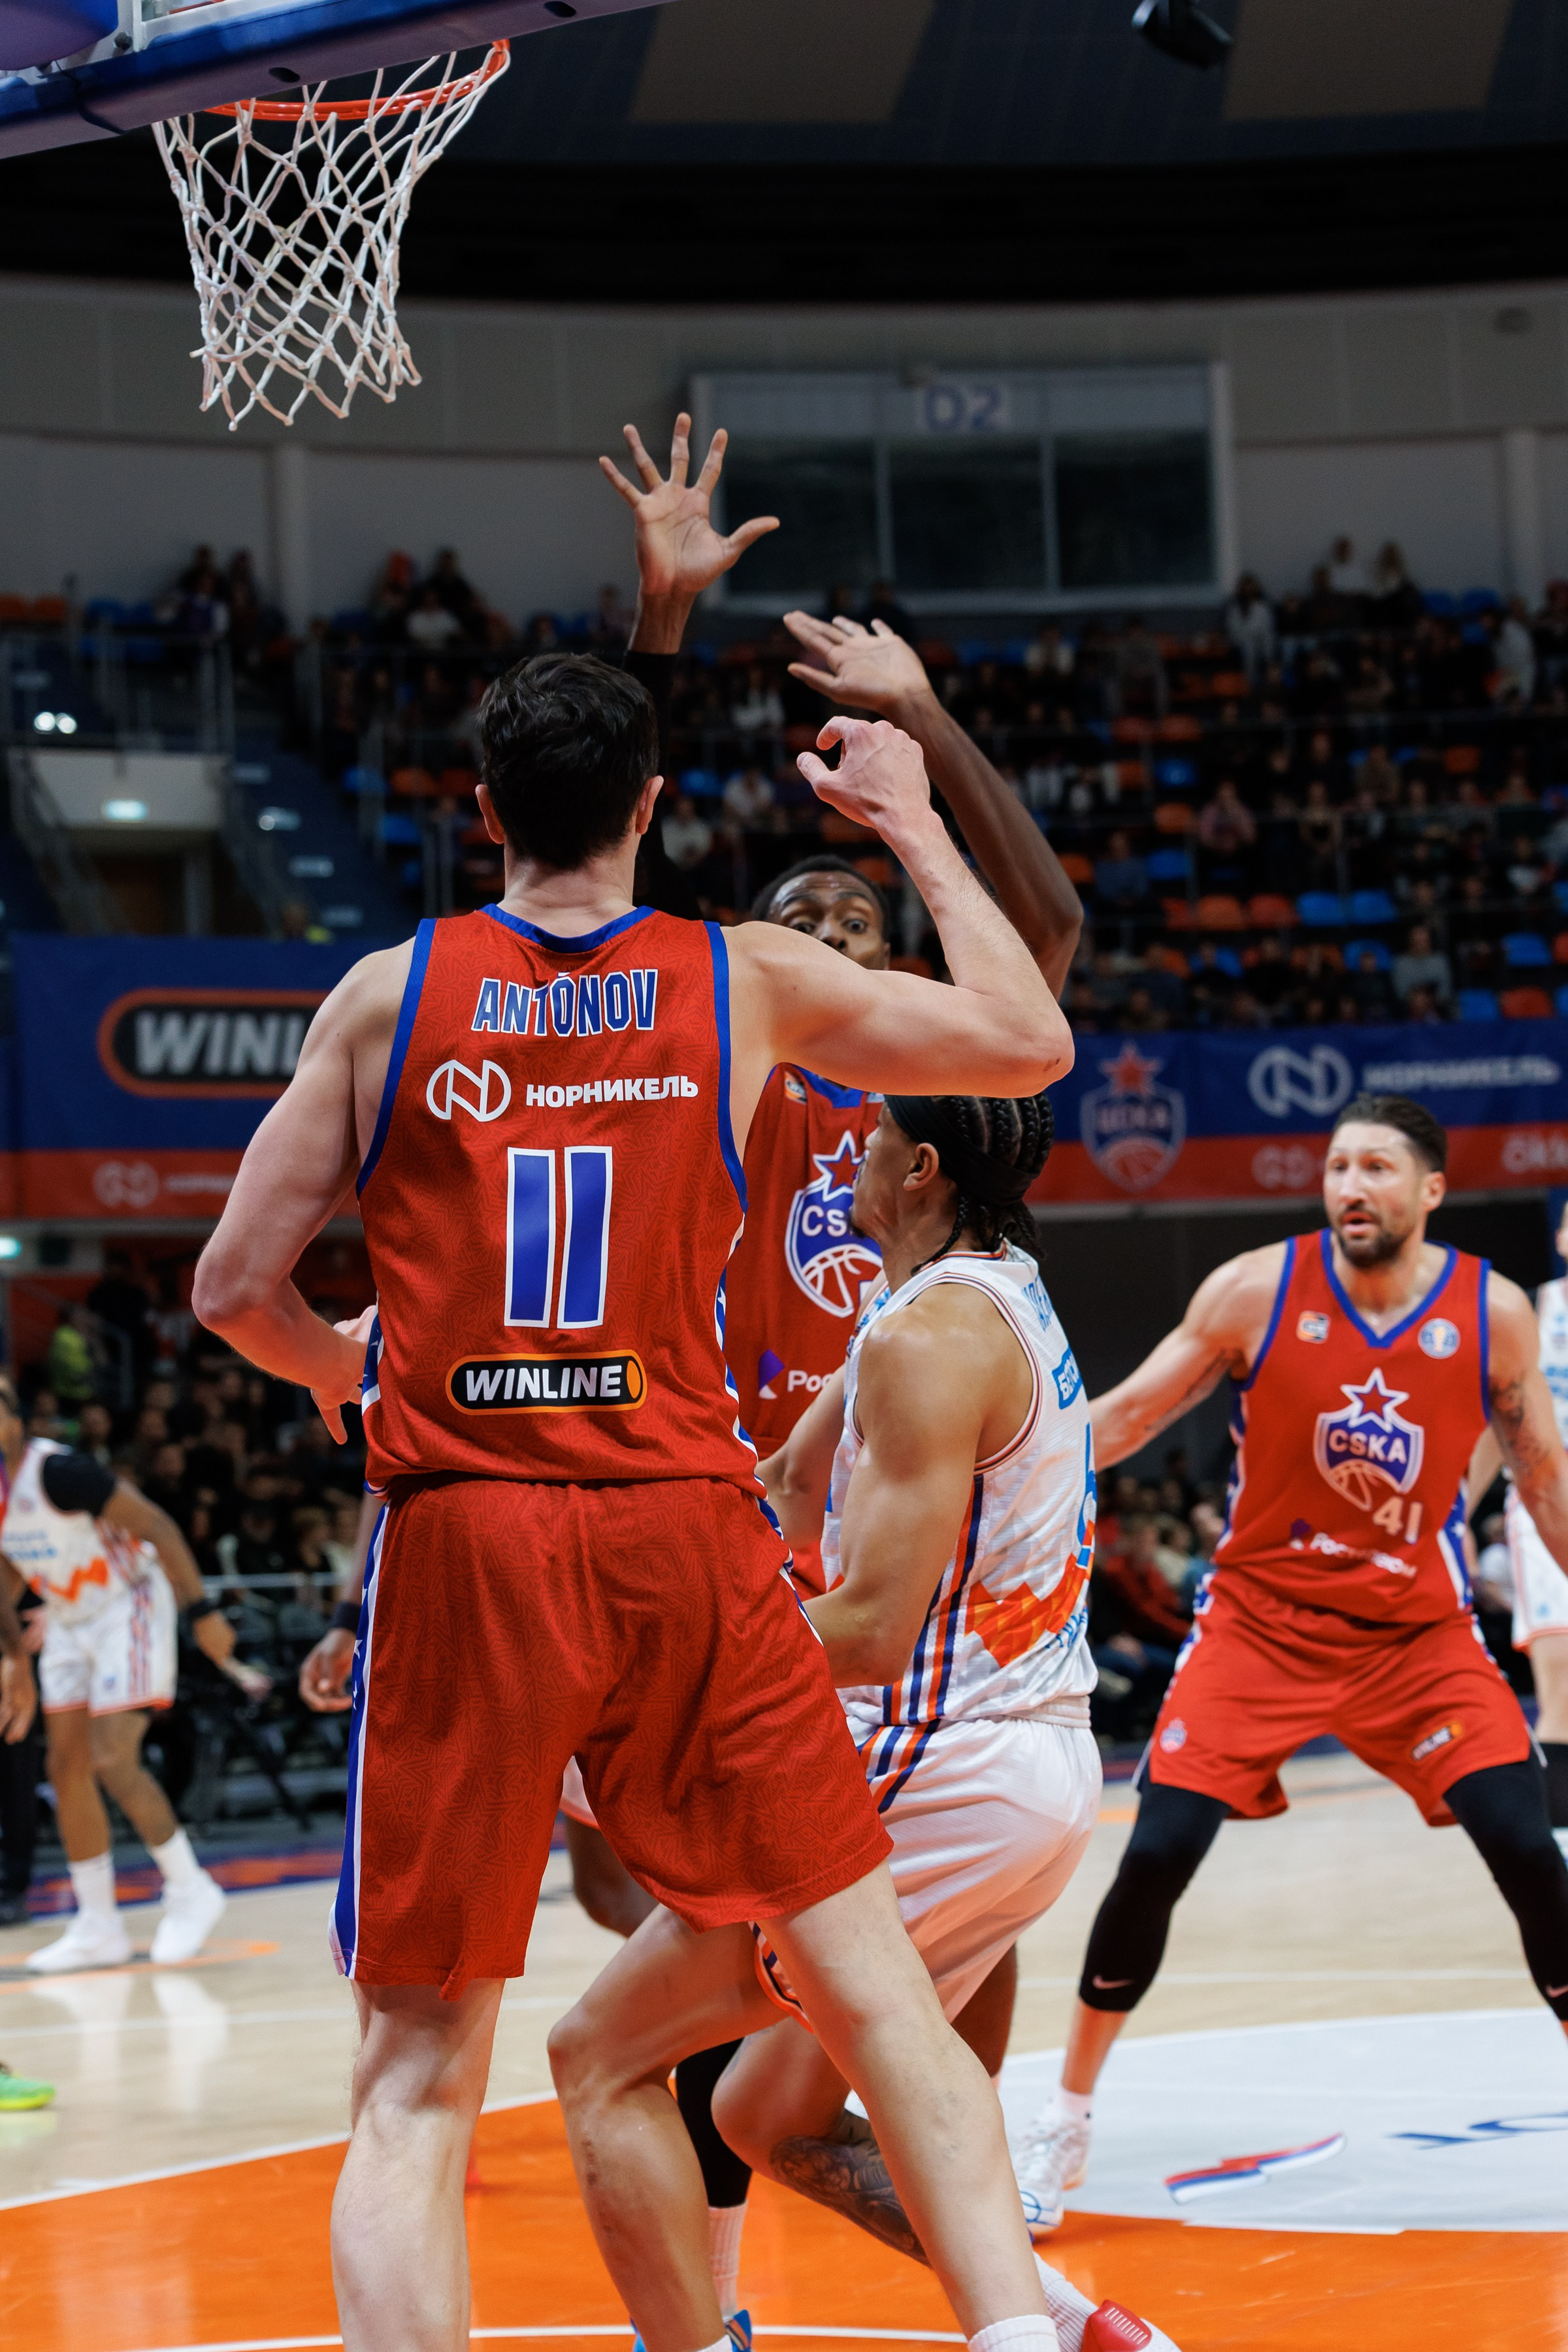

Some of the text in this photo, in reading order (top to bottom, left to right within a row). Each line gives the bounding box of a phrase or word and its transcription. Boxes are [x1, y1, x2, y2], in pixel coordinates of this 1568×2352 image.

[470, 968, 659, 1037] ANTONOV
[525, 1075, 699, 1108] НОРНИКЕЛЬ
[504, 1145, 613, 1330] 11
[801, 1204, 853, 1237] CS
[466, 1364, 622, 1401] WINLINE
[1328, 1428, 1407, 1465] CSKA
[1373, 1495, 1424, 1545] 41
